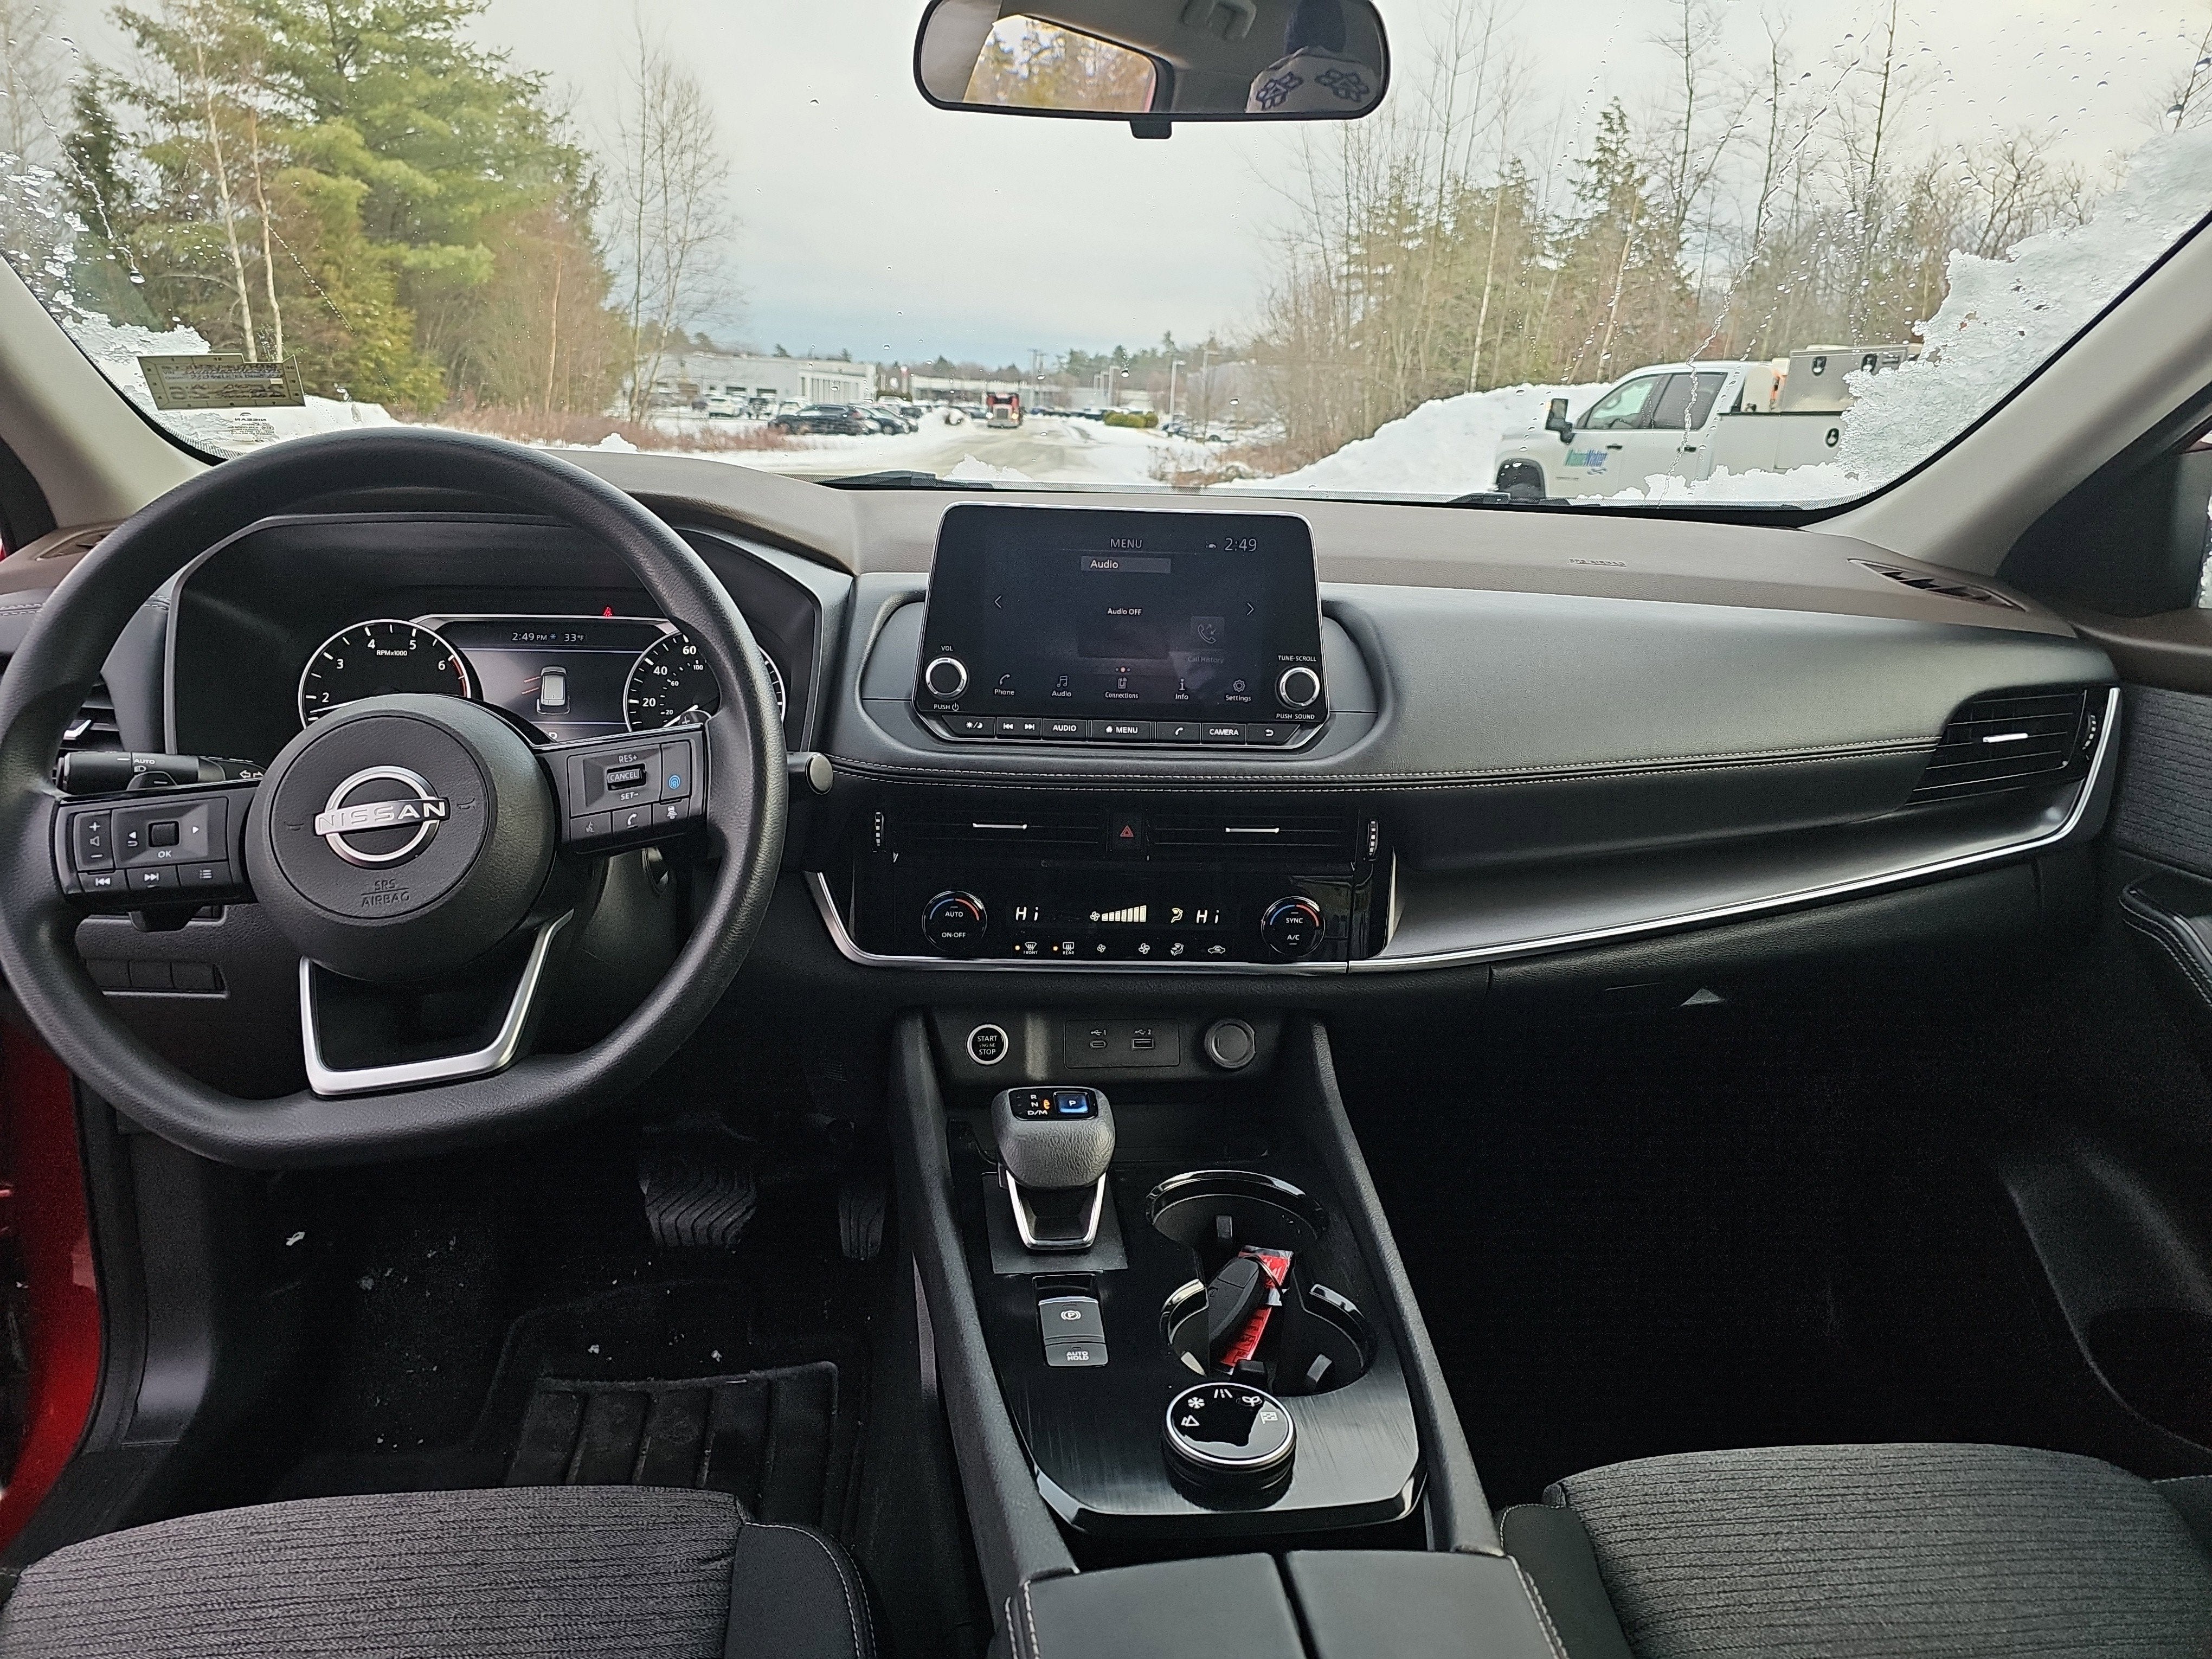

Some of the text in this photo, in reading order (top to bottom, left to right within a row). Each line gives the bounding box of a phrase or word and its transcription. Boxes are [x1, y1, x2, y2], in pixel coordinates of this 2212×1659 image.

[1110, 538, 1142, 548] MENU
[1224, 538, 1257, 551] 2:49
[1090, 559, 1118, 569] Audio
[512, 632, 535, 641] 2:49
[367, 639, 376, 649] 4
[409, 640, 416, 650] 5
[683, 645, 697, 655] 60
[336, 659, 344, 669] 3
[438, 660, 446, 671] 6
[653, 666, 668, 676] 40
[321, 692, 330, 703] 2
[642, 697, 656, 707] 20
[1225, 695, 1251, 703] Settings
[610, 771, 638, 782] CANCEL
[318, 801, 446, 833] NISSAN
[158, 850, 172, 858] OK
[374, 878, 397, 891] SRS
[362, 891, 410, 908] AIRBAG
